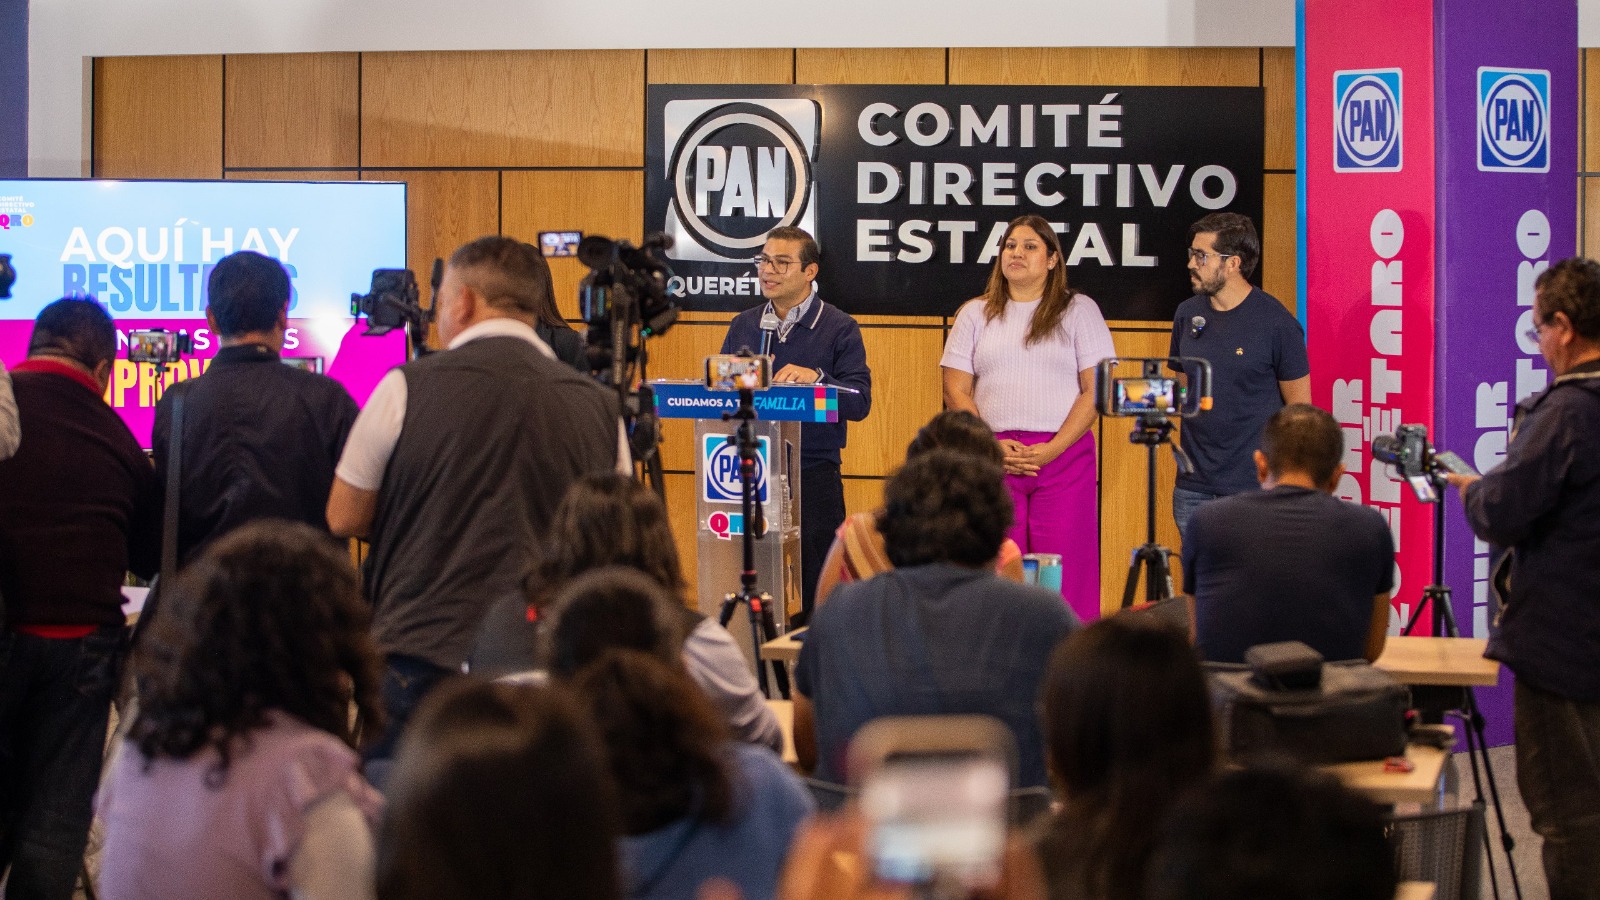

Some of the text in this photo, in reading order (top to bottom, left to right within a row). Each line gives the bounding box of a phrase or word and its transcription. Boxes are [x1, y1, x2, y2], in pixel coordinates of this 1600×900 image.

[857, 93, 1124, 149] COMITÉ
[1350, 99, 1389, 143] PAN
[1495, 99, 1534, 142] PAN
[695, 145, 787, 218] PAN
[857, 162, 1238, 210] DIRECTIVO
[0, 213, 34, 230] QRO
[60, 218, 184, 269] AQUÍ
[201, 227, 300, 262] HAY
[63, 263, 299, 312] RESULT
[666, 271, 819, 298] QUERÉT
[667, 397, 723, 408] CUIDAMOS
[725, 399, 734, 408] A
[752, 396, 806, 411] FAMILIA
[719, 454, 757, 484] PA
[708, 511, 770, 540] QR
